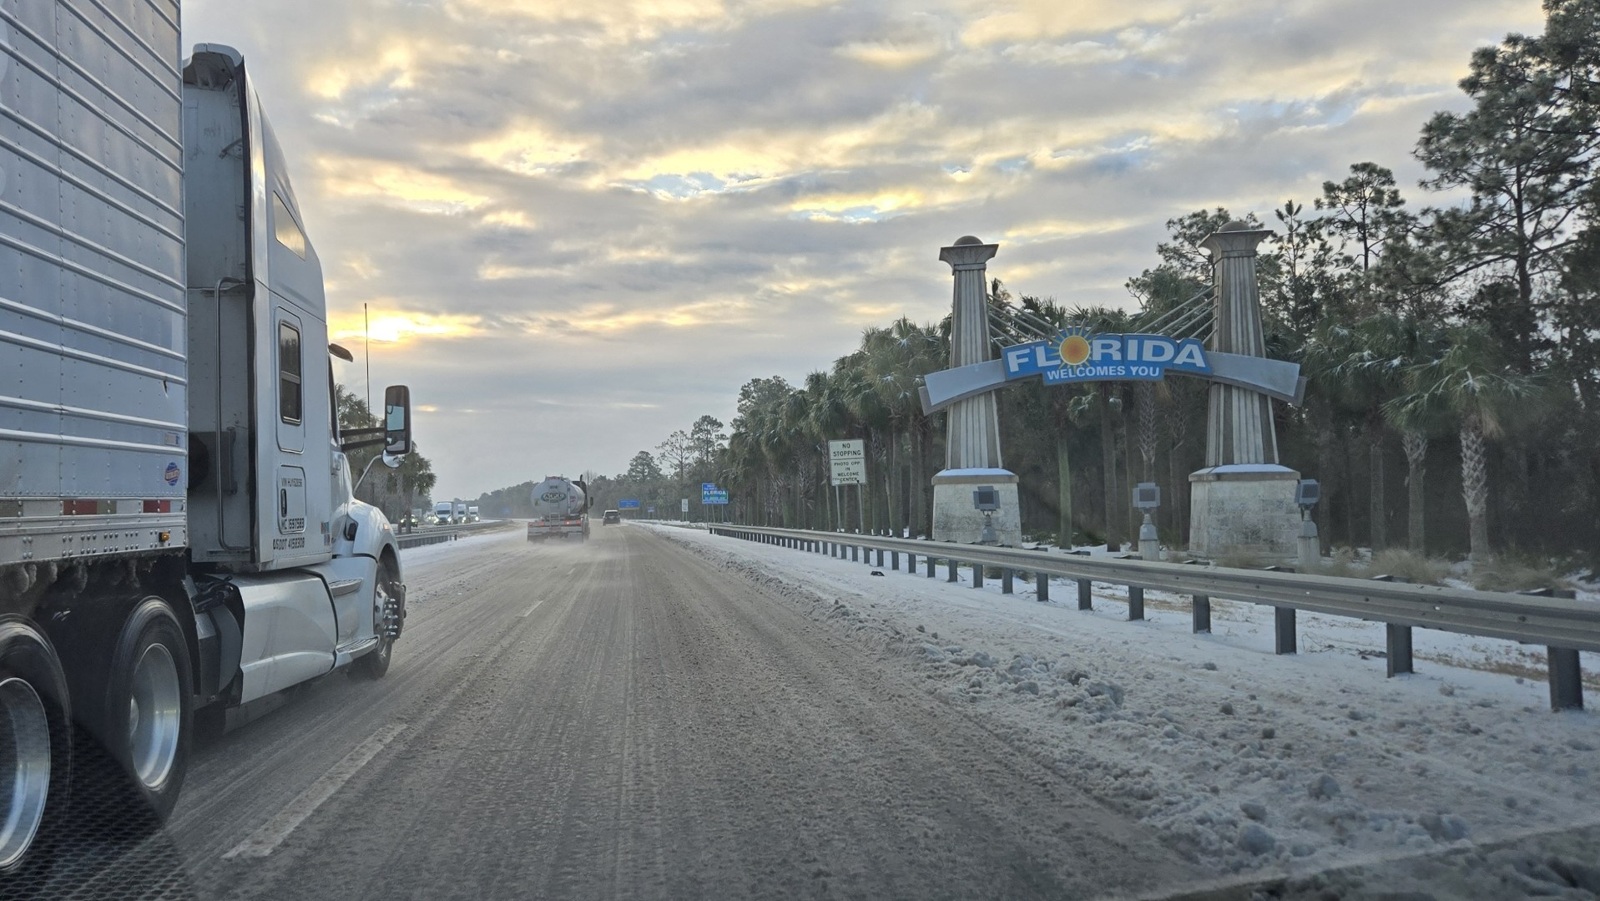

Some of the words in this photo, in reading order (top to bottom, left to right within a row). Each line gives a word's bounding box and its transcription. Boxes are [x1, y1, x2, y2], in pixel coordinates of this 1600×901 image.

[1007, 335, 1206, 373] FLORIDA
[1046, 366, 1126, 381] WELCOMES
[1130, 366, 1160, 378] YOU
